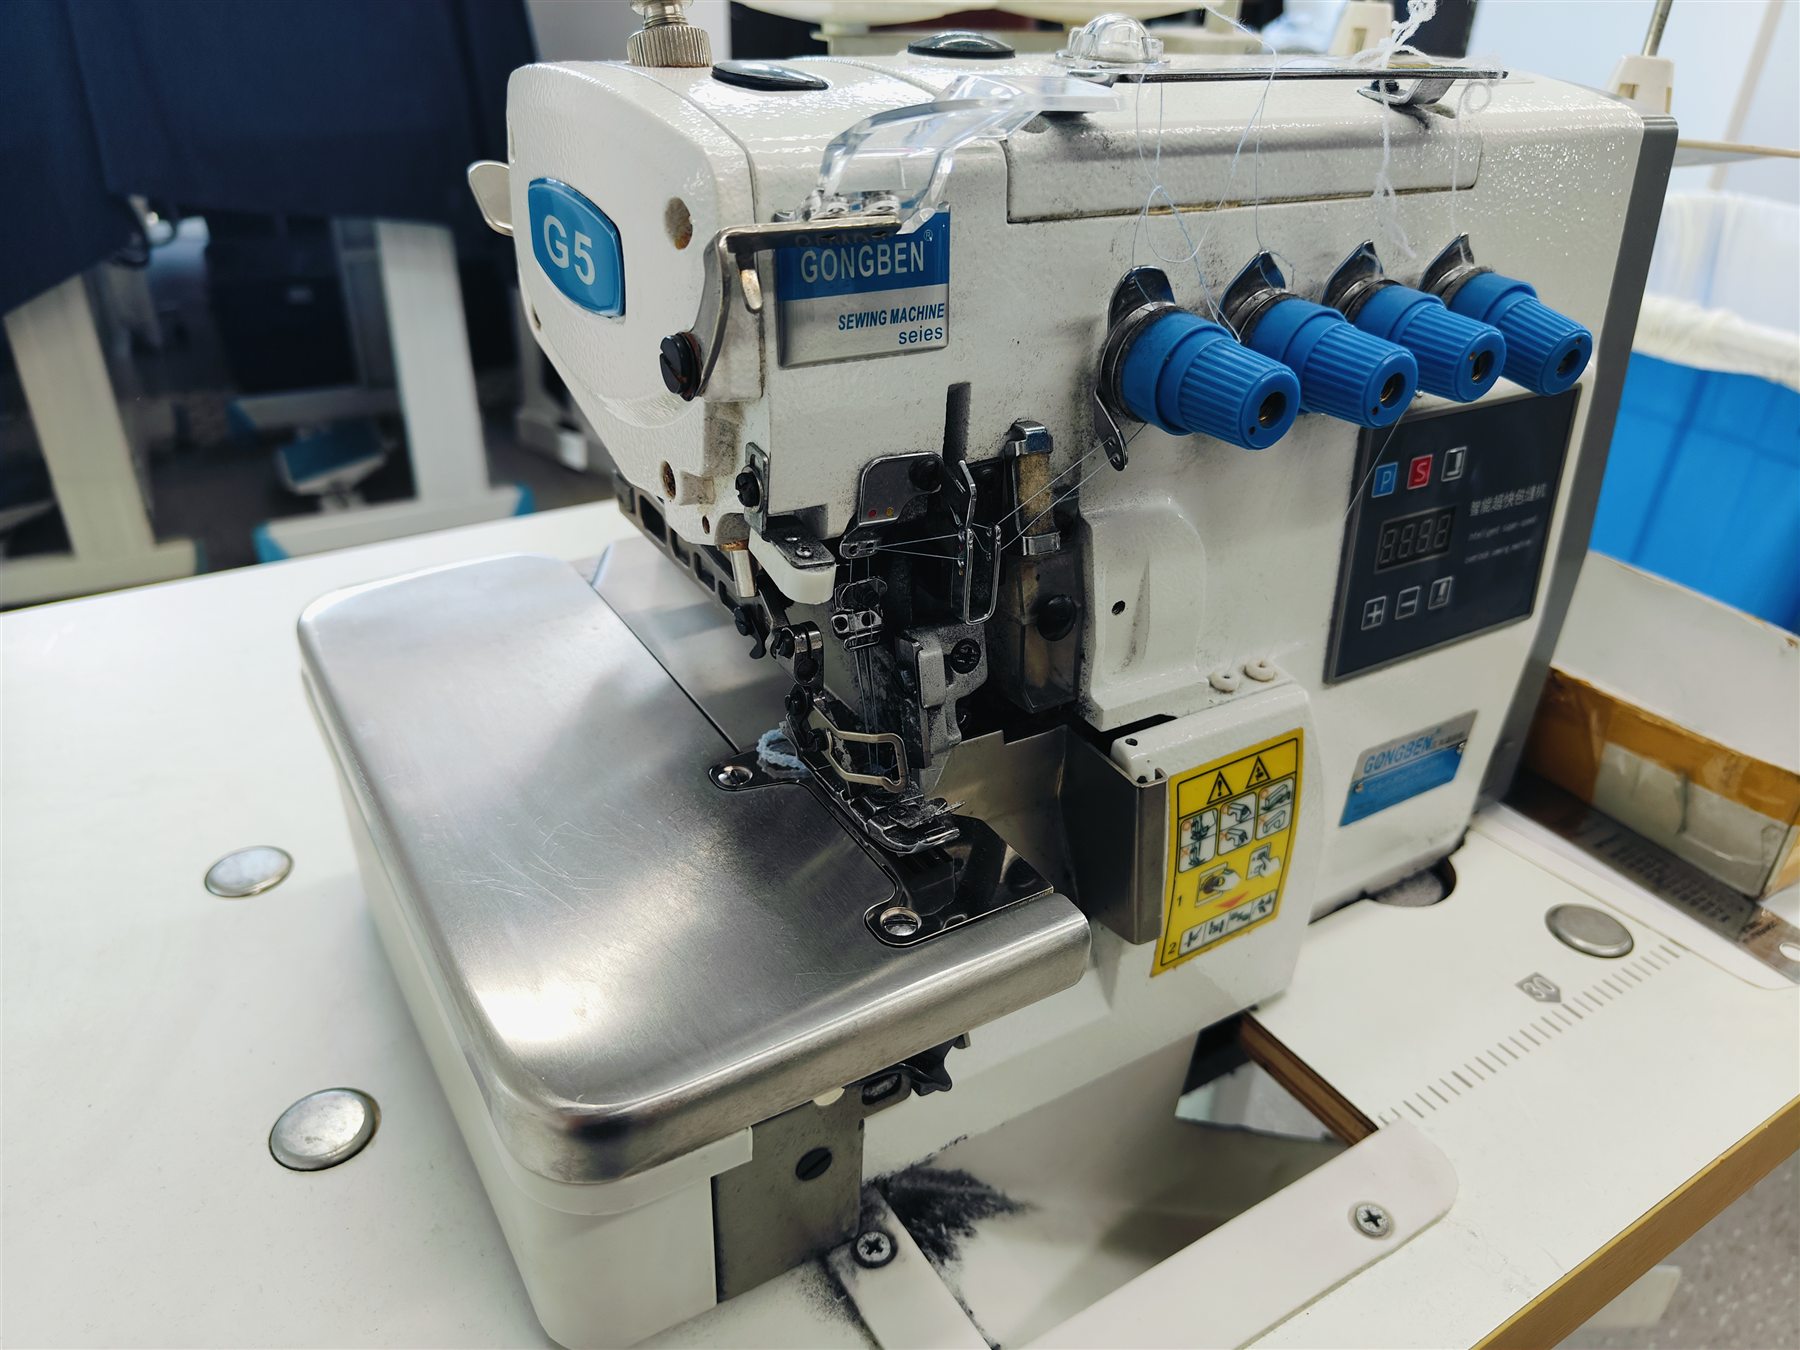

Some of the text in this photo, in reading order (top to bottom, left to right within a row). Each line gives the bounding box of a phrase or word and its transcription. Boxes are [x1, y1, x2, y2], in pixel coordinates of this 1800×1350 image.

[543, 214, 596, 286] G5
[801, 241, 925, 283] GONGBEN
[838, 303, 945, 331] SEWING MACHINE
[898, 325, 943, 345] seies
[1381, 462, 1428, 492] P S
[1364, 735, 1434, 774] GONGBEN
[1167, 941, 1177, 956] 2
[1522, 975, 1556, 999] 30
